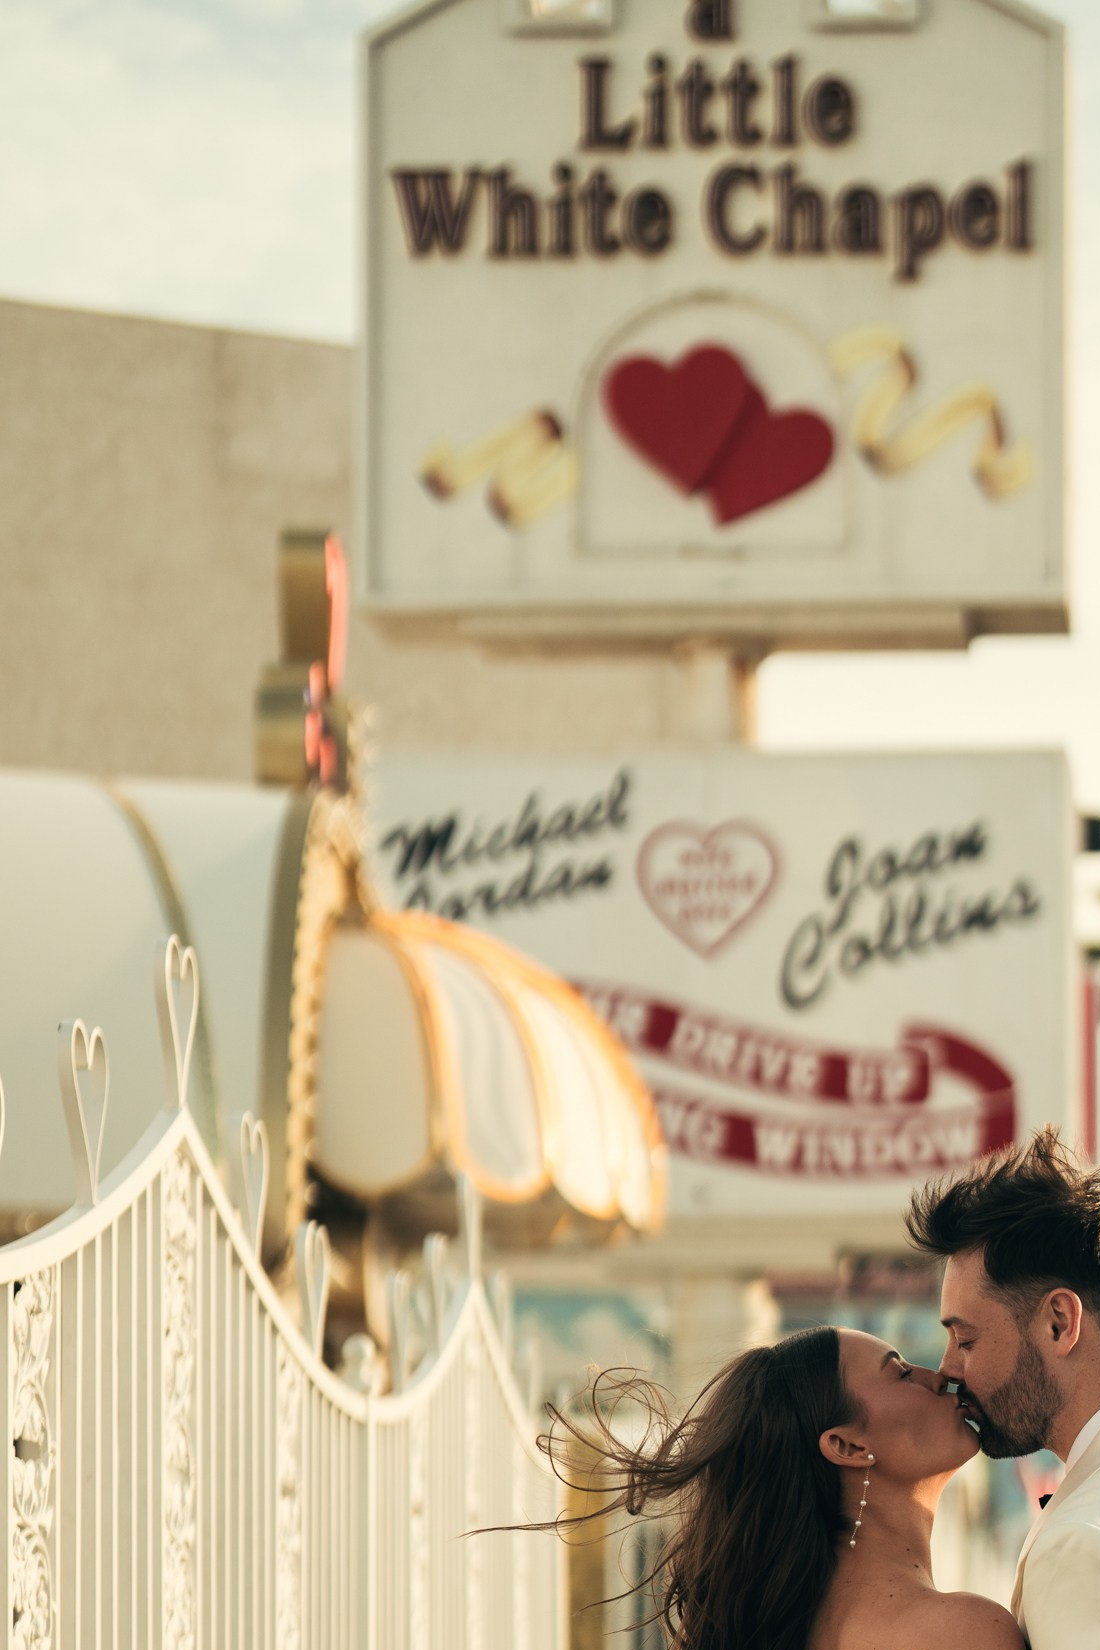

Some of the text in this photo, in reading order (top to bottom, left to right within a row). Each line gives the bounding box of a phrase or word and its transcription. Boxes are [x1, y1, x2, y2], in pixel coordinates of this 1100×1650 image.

[577, 54, 858, 152] Little
[390, 156, 1034, 284] White Chapel
[381, 766, 630, 878] Michael
[402, 855, 613, 921] ordan
[825, 818, 987, 940] Joan
[779, 877, 1041, 1013] Collins
[671, 1018, 820, 1091] DRIVE
[752, 1115, 979, 1171] WINDOW
